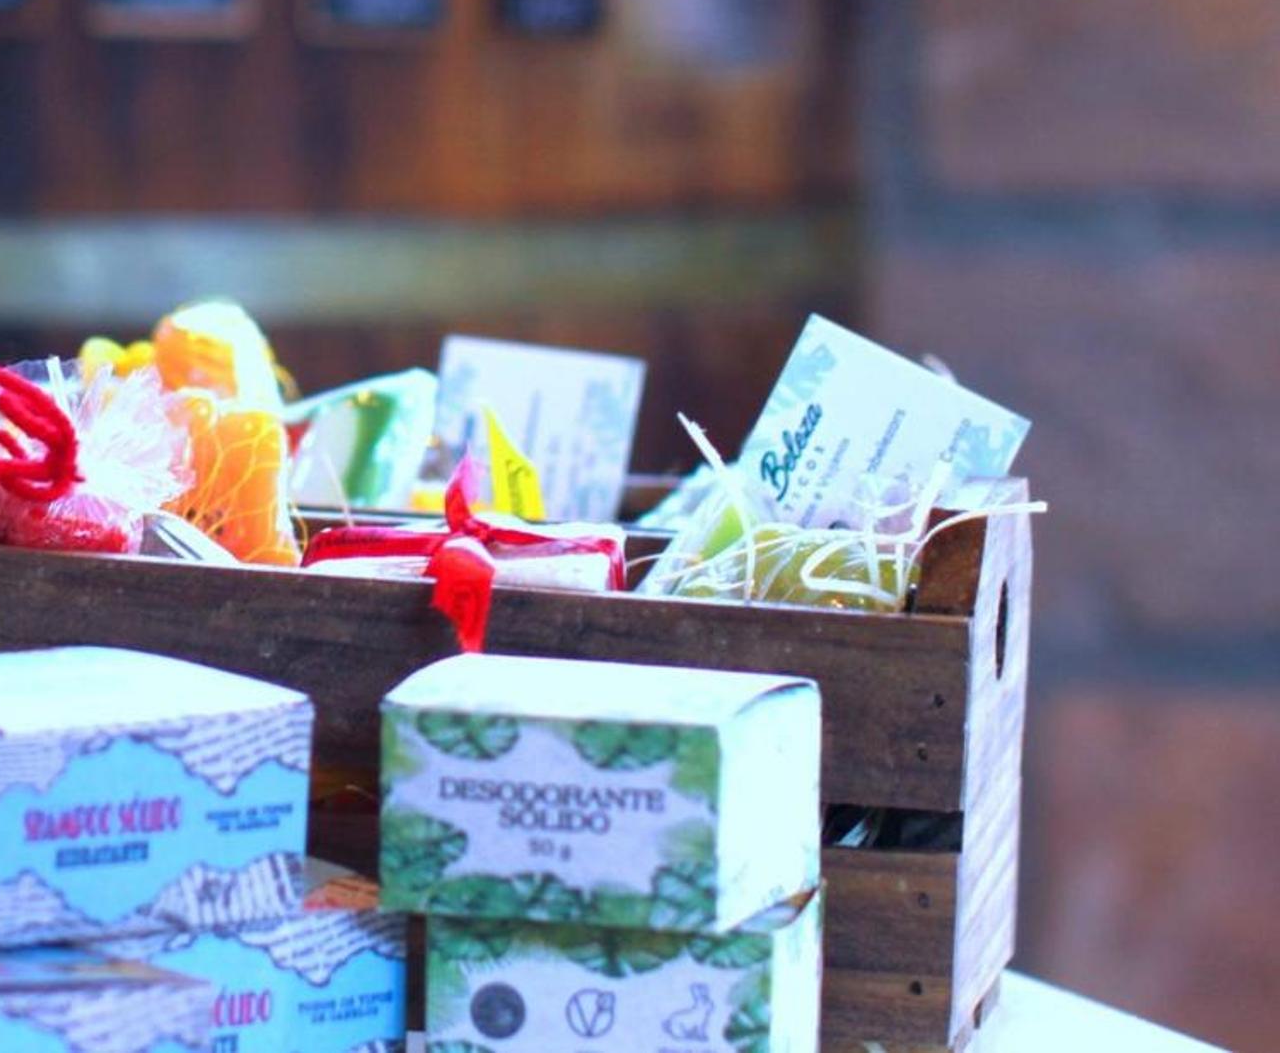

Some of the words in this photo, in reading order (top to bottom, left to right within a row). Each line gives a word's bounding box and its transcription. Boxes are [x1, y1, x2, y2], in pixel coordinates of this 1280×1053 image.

[760, 402, 823, 503] Beleza
[118, 792, 183, 834] SÓLIDO
[438, 776, 667, 814] DESODORANTE
[211, 987, 272, 1028] ÓLIDO
